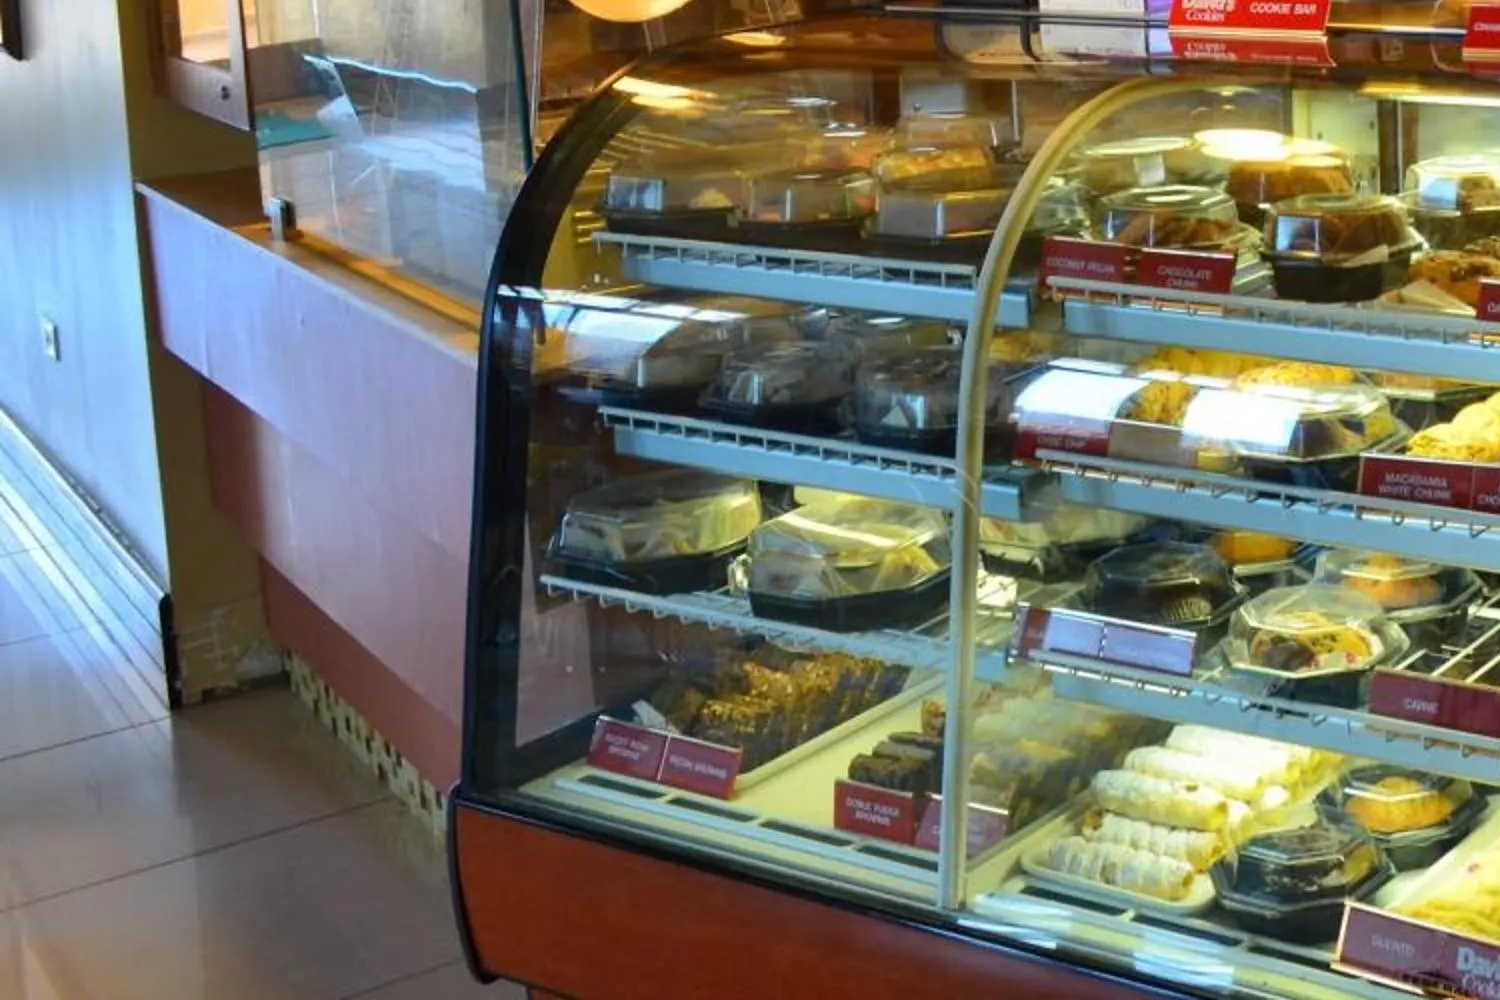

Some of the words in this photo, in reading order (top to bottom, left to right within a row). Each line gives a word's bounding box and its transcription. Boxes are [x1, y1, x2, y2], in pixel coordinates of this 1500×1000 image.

[1249, 2, 1289, 16] COOKIE
[1293, 3, 1317, 16] BAR
[1156, 264, 1213, 280] CHOCOLATE
[1384, 471, 1448, 488] MACADAMIA
